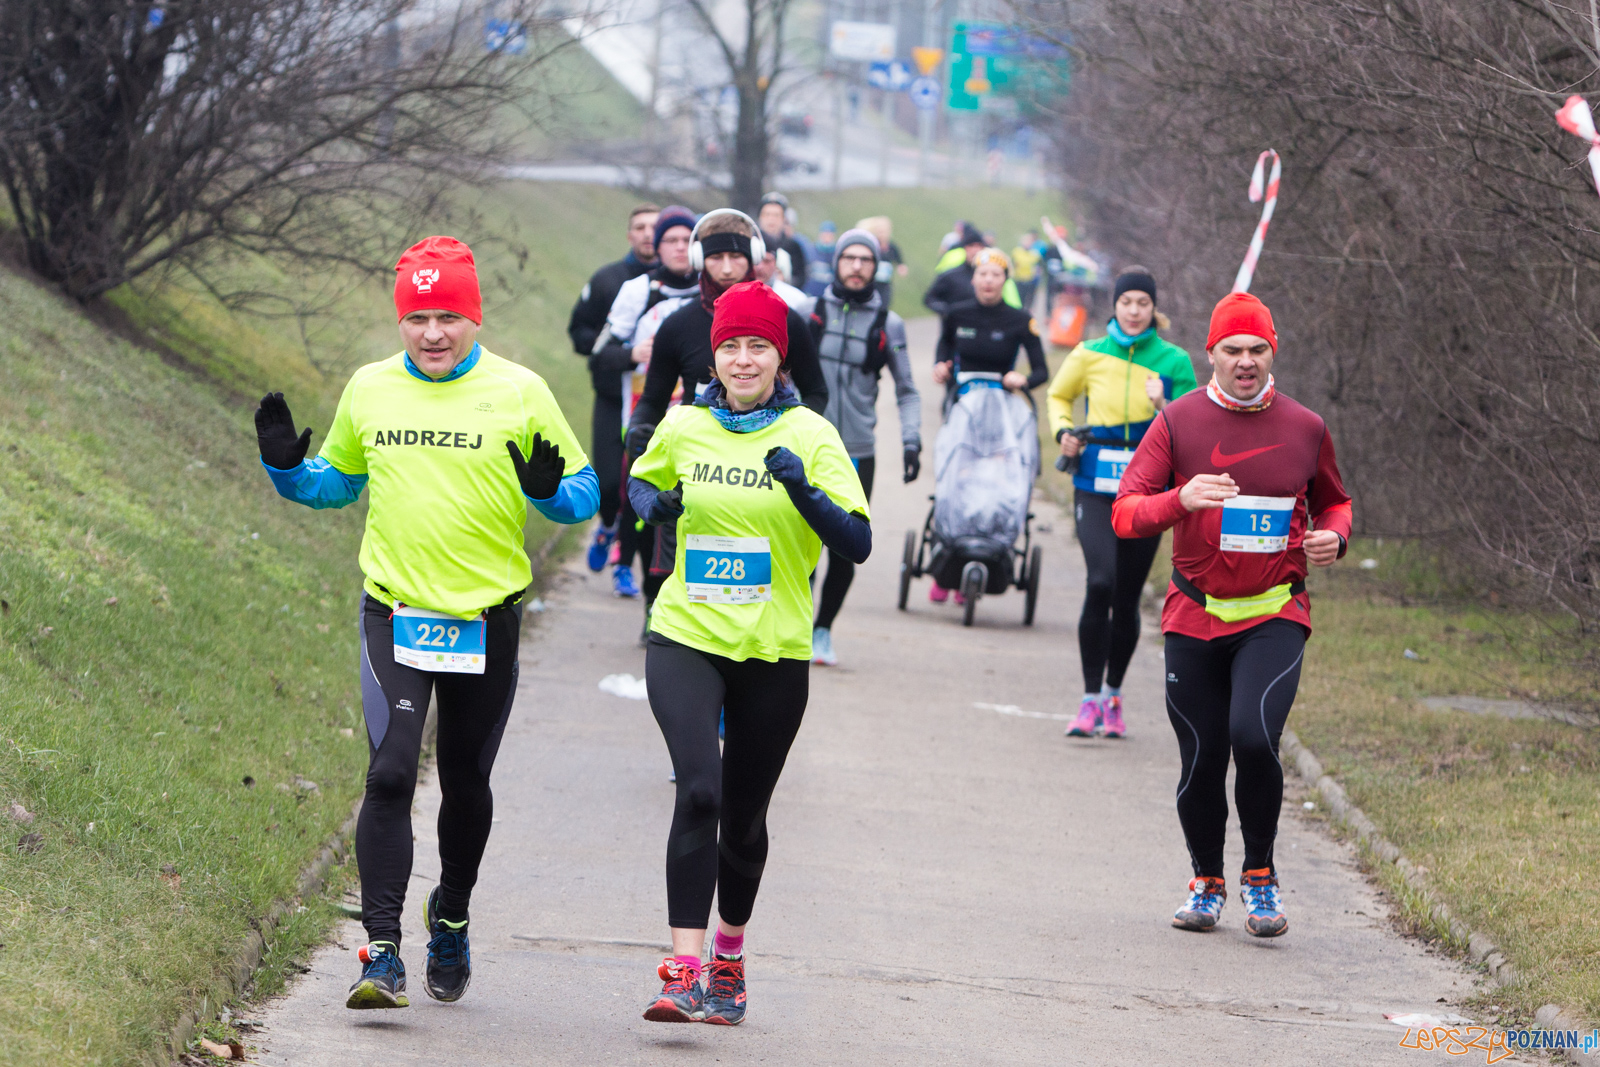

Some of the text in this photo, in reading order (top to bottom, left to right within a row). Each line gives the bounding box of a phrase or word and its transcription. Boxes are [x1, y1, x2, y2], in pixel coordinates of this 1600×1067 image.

[374, 429, 483, 450] ANDRZEJ
[692, 463, 774, 491] MAGDA
[1249, 514, 1272, 533] 15
[703, 556, 746, 581] 228
[415, 623, 461, 648] 229
